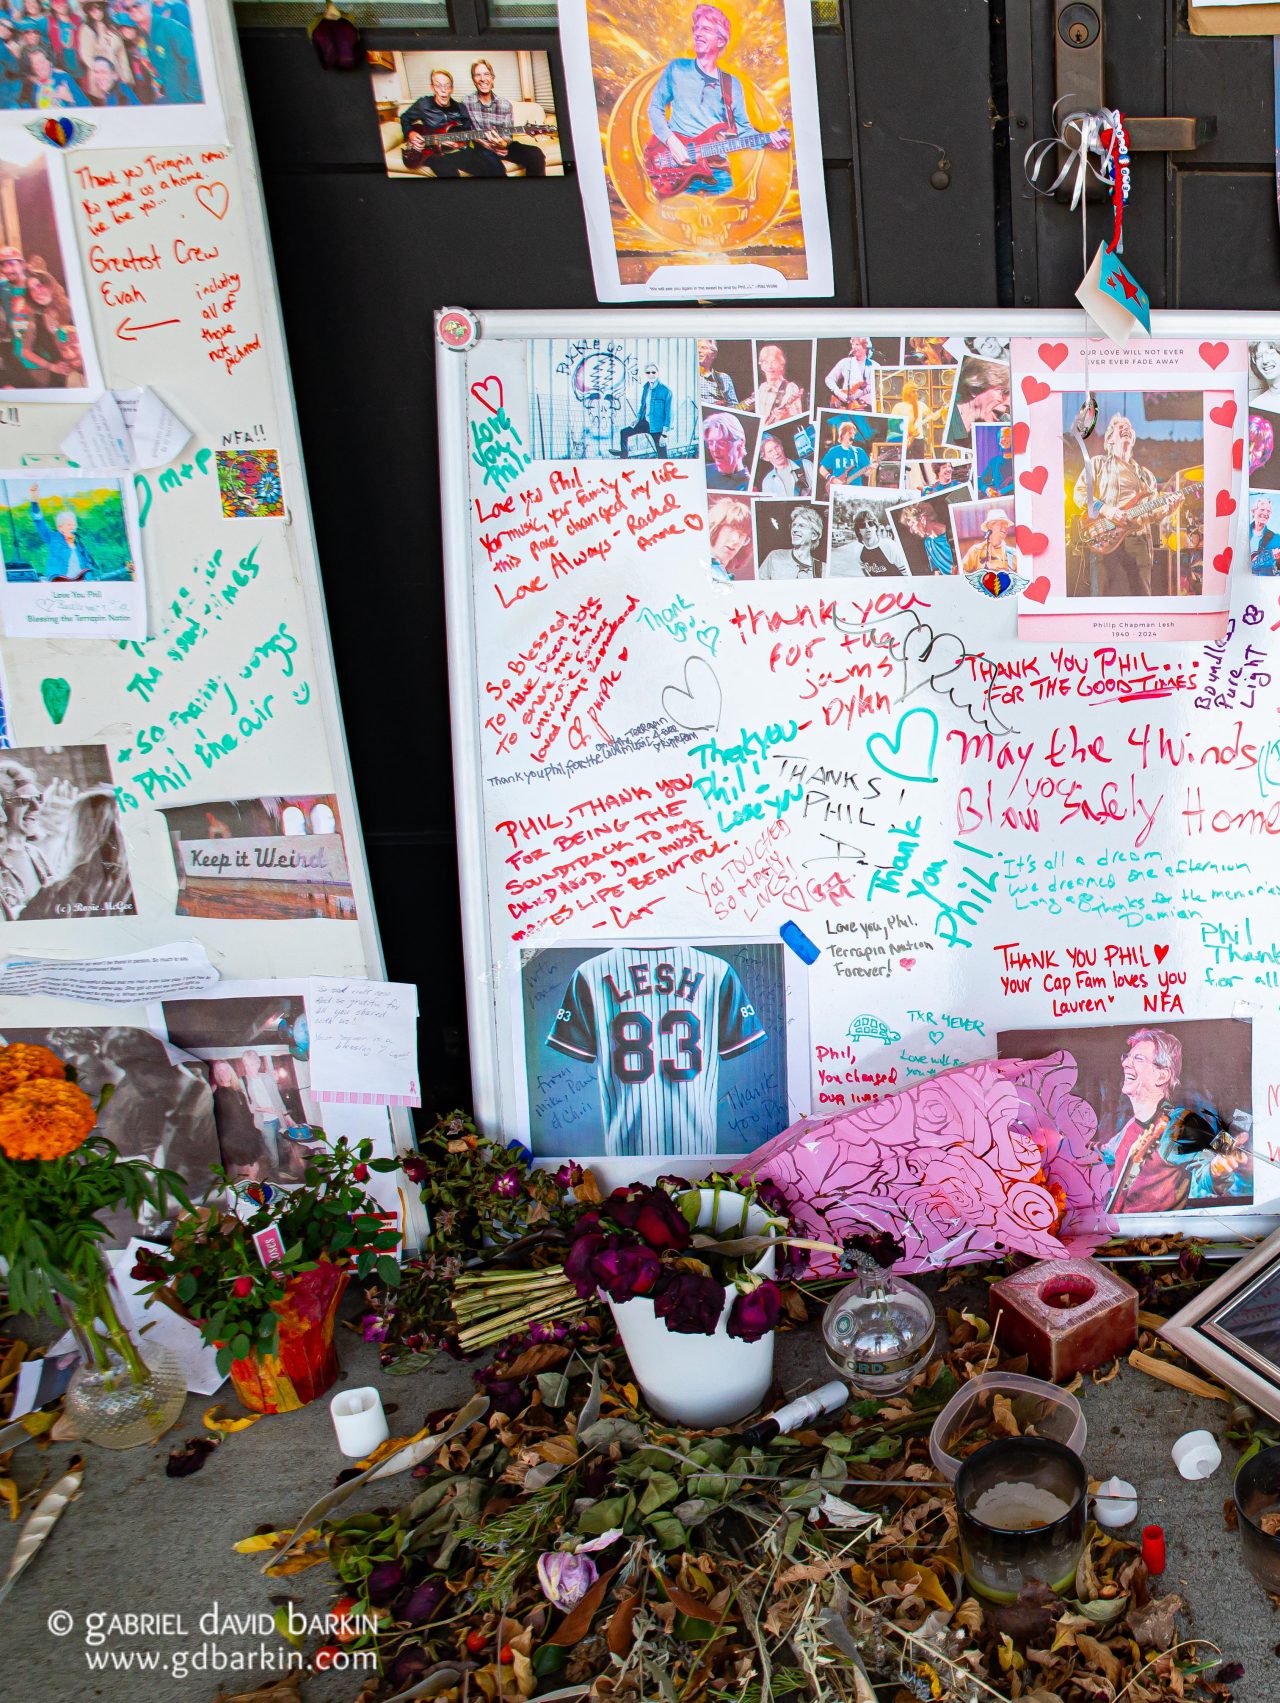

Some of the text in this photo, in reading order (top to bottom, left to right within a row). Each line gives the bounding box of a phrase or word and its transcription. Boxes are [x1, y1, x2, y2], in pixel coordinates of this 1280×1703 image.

[89, 239, 219, 274] Greatest Crew
[53, 591, 70, 599] Love
[87, 590, 102, 598] Phil
[27, 615, 59, 624] Blessing
[74, 614, 105, 623] Terrapin
[730, 591, 931, 645] thank you
[1093, 621, 1116, 629] Philip
[1118, 621, 1154, 629] Chapman
[840, 631, 900, 654] the
[800, 656, 894, 699] jams
[955, 651, 1039, 682] THANK
[1050, 648, 1088, 674] YOU
[821, 683, 891, 731] Dylan
[983, 682, 1024, 711] FOR
[1029, 677, 1069, 699] THE
[945, 729, 1035, 799] May
[1044, 724, 1113, 767] the
[1024, 777, 1082, 805] you
[1060, 772, 1164, 848] Safely
[190, 847, 327, 874] Keep it Weird
[72, 901, 98, 914] Rosie
[100, 901, 134, 913] McGee
[993, 941, 1152, 972] THANK YOU PHIL
[602, 962, 705, 1004] LESH
[1042, 971, 1073, 995] Cap
[1076, 970, 1108, 991] Fam
[1112, 969, 1149, 989] loves
[1159, 970, 1188, 998] you
[557, 1008, 572, 1022] 83
[740, 1004, 755, 1018] 83
[1051, 993, 1186, 1017] Lauren NFA
[611, 1008, 702, 1085] 83
